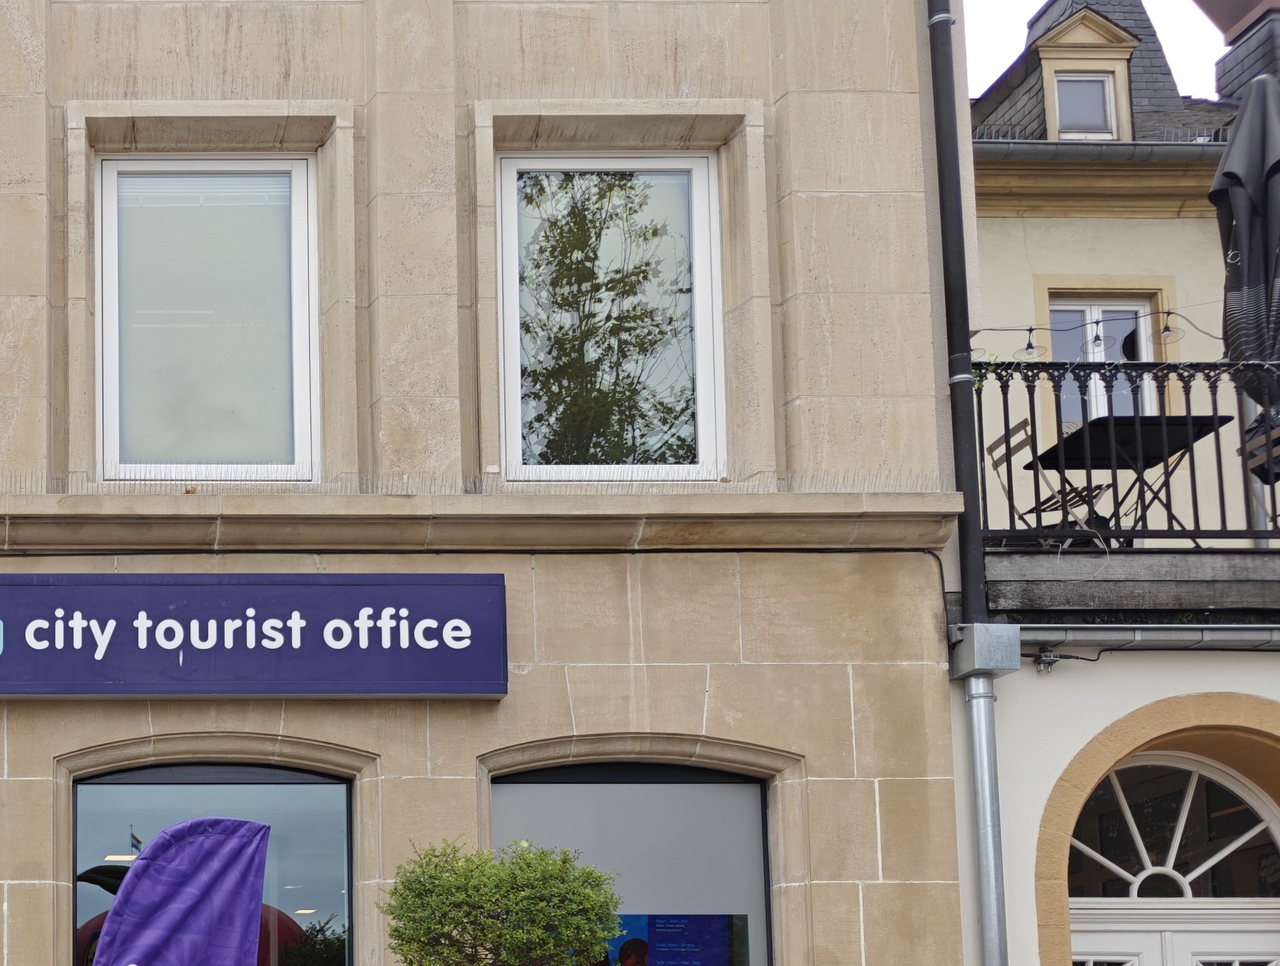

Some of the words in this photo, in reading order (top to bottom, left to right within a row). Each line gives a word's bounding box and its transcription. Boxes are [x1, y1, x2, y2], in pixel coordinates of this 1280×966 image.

[24, 607, 117, 661] city
[132, 607, 307, 650] tourist
[323, 606, 472, 650] office
